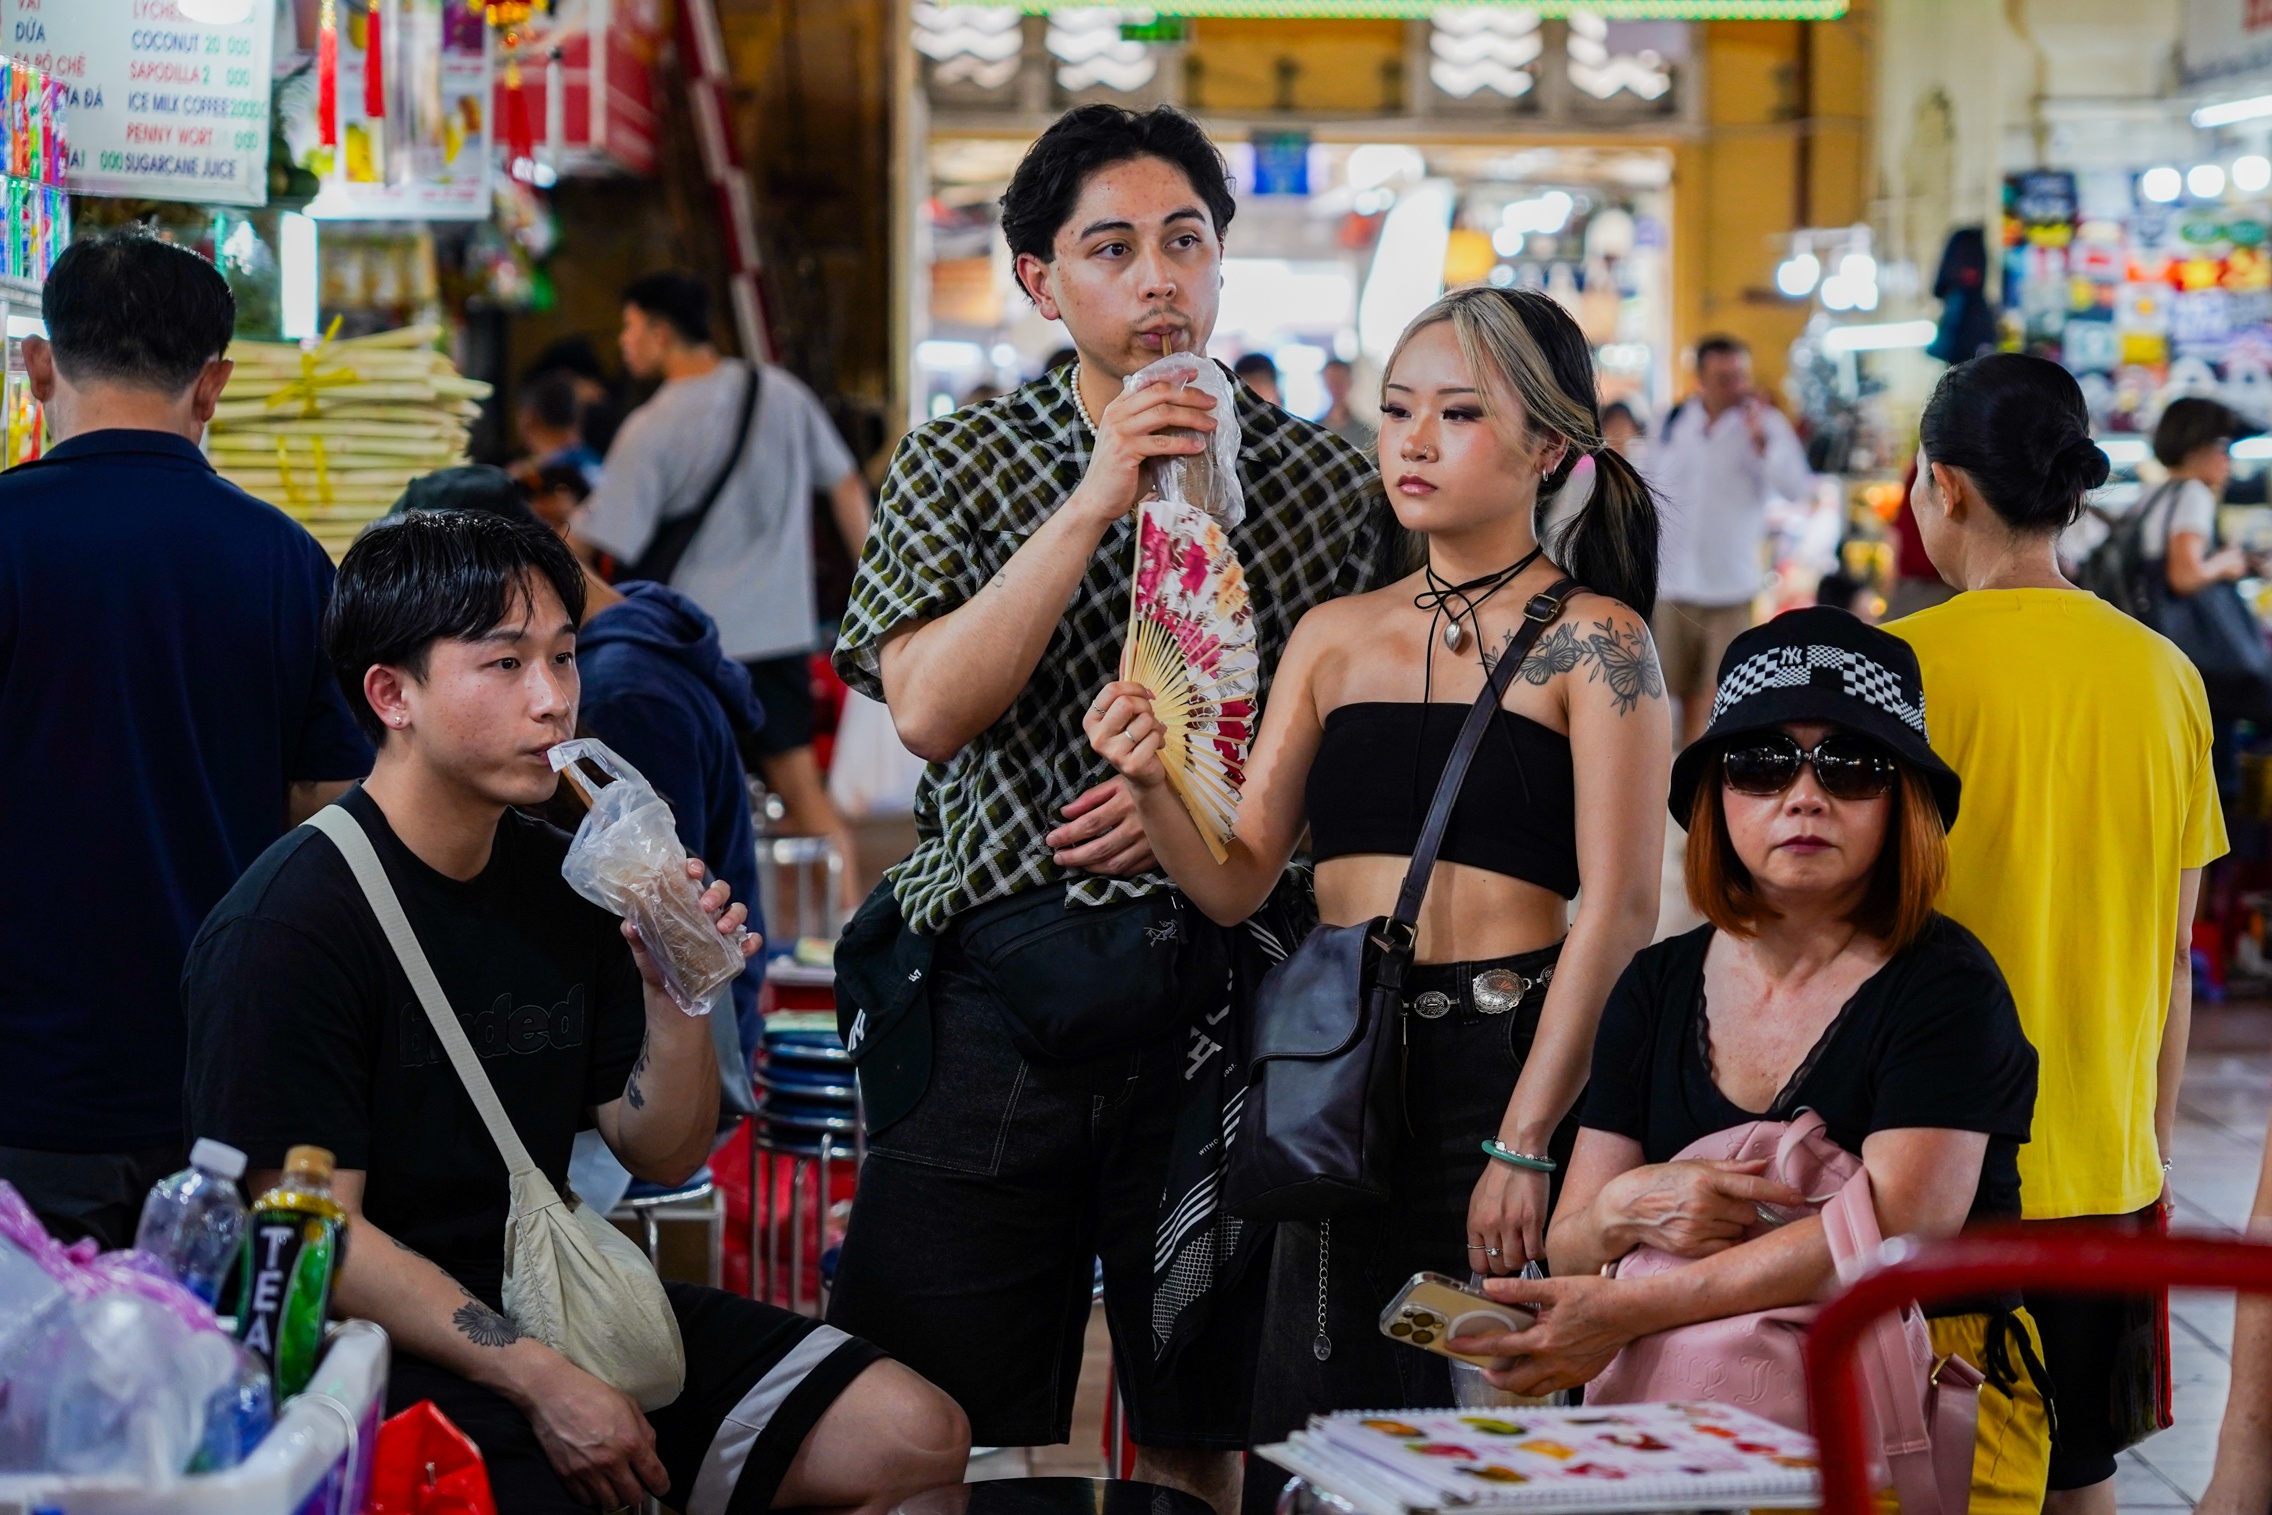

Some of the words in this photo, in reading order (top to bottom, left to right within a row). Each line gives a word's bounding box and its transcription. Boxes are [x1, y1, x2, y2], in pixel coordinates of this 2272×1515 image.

[131, 29, 199, 53] COCONUT
[129, 59, 200, 83] SAPODILLA
[127, 91, 149, 112] ICE
[153, 93, 179, 114] MILK
[183, 95, 229, 118] COFFEE
[126, 121, 172, 143] PENNY
[177, 126, 214, 148] WORT
[124, 152, 199, 177] SUGARCANE
[202, 157, 237, 180] JUICE
[1780, 645, 1803, 665] NY
[243, 1226, 295, 1355] TEA
